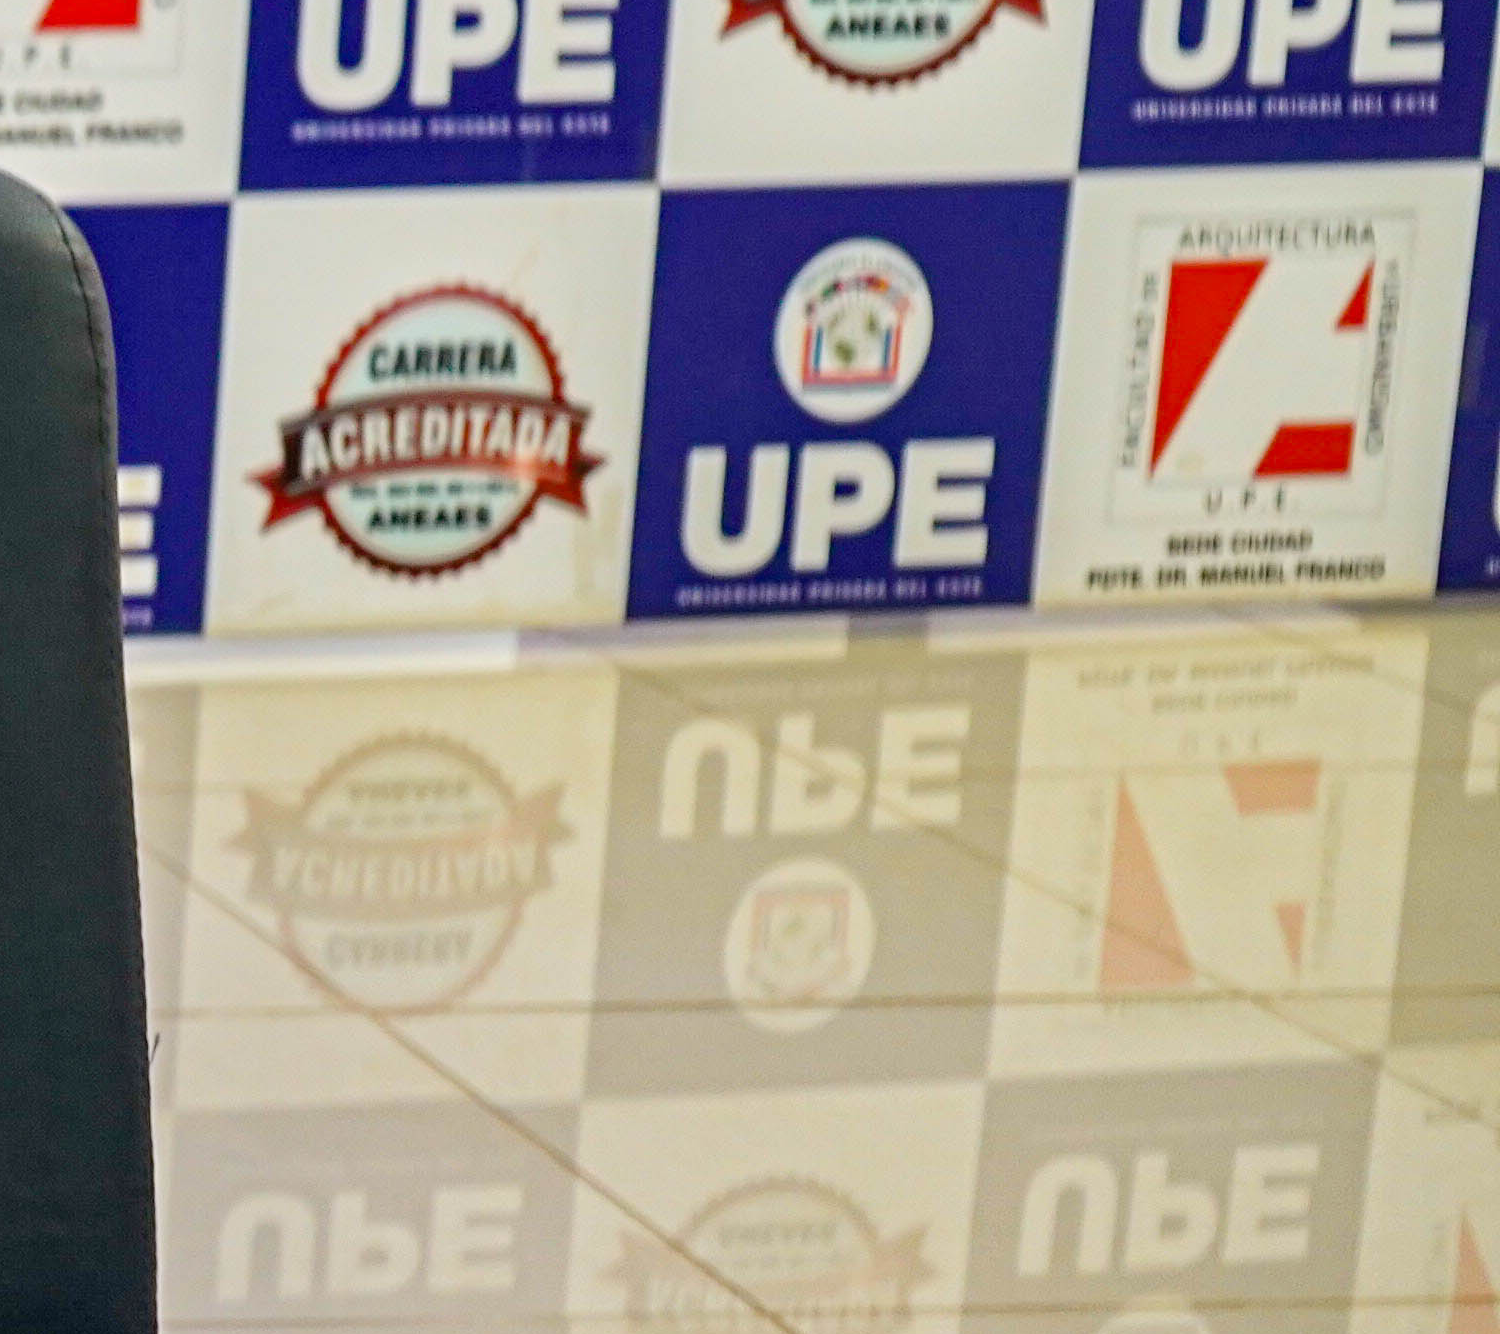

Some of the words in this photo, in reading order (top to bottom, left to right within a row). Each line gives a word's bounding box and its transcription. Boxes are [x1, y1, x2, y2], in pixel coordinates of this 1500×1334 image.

[83, 119, 184, 145] FRANCO
[1177, 223, 1377, 254] ARQUITECTURA
[367, 341, 519, 382] CARRERA
[298, 403, 572, 481] ACREDITADA
[680, 437, 996, 577] UPE
[1294, 558, 1388, 583] FRANCO
